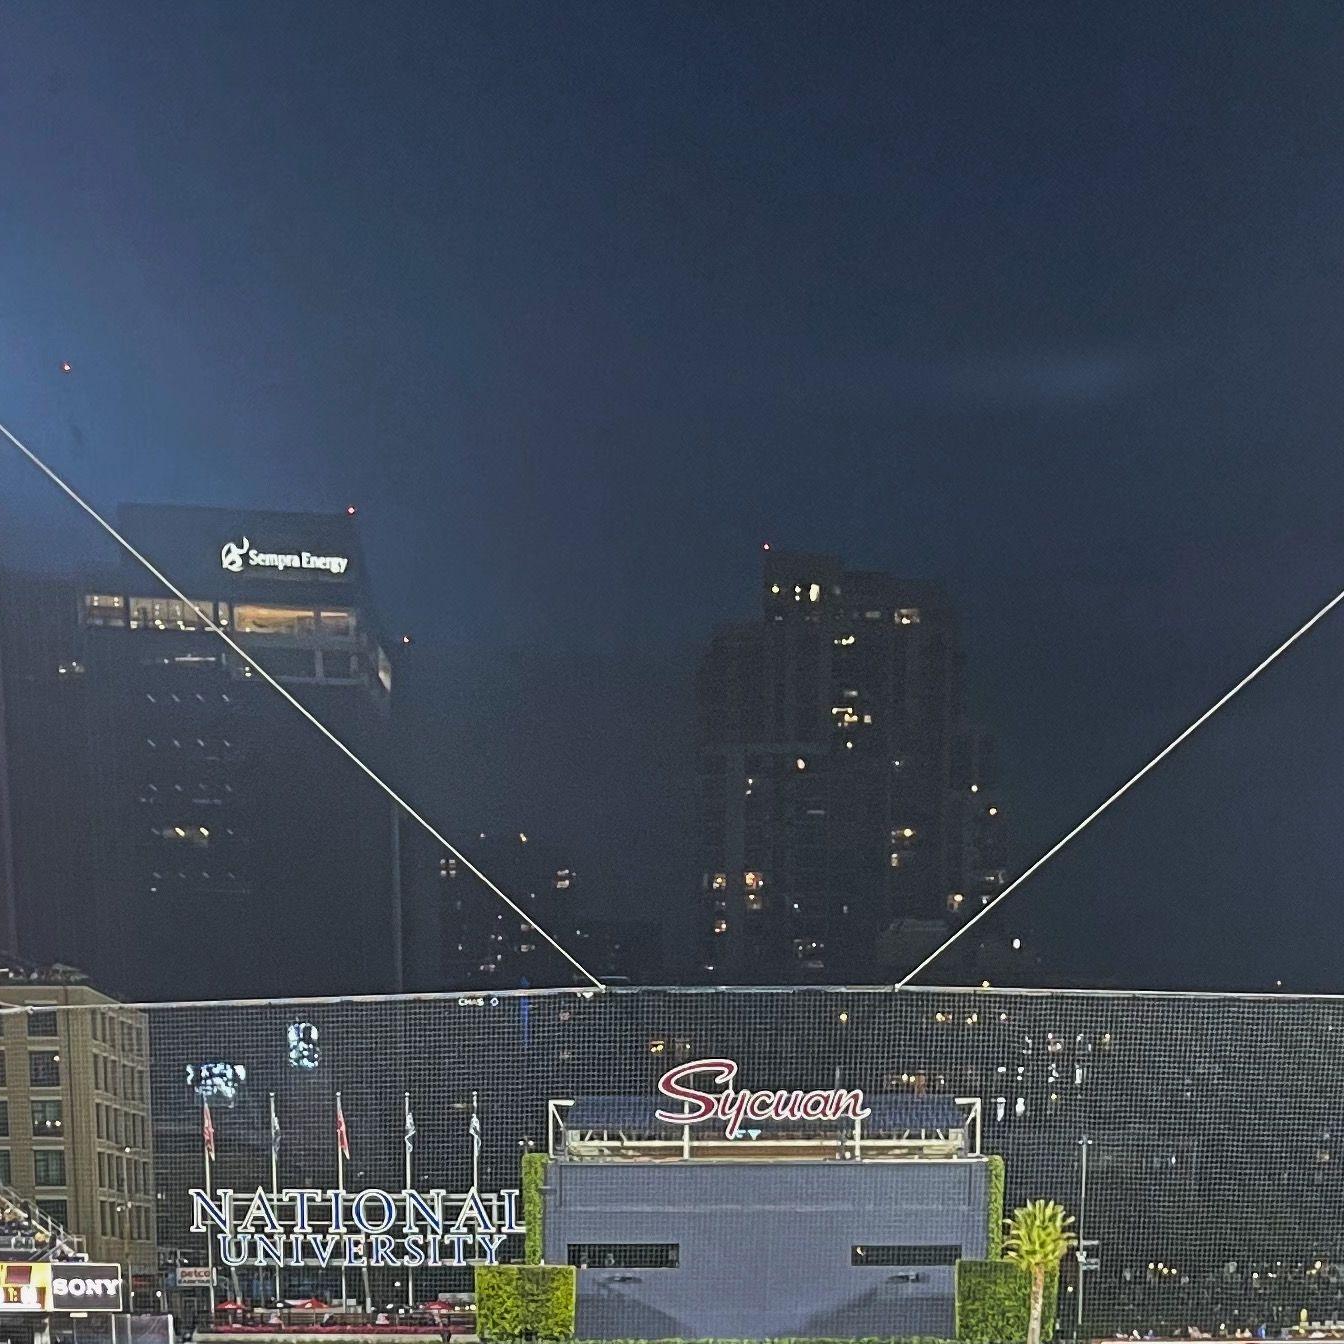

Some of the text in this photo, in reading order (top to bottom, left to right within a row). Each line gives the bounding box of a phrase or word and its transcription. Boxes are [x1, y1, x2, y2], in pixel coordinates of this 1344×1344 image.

[249, 549, 348, 573] Sempra Energy
[655, 1059, 872, 1140] Sycuan
[189, 1186, 527, 1234] NATIONAL
[217, 1234, 507, 1268] UNIVERSITY
[53, 1278, 122, 1297] SONY
